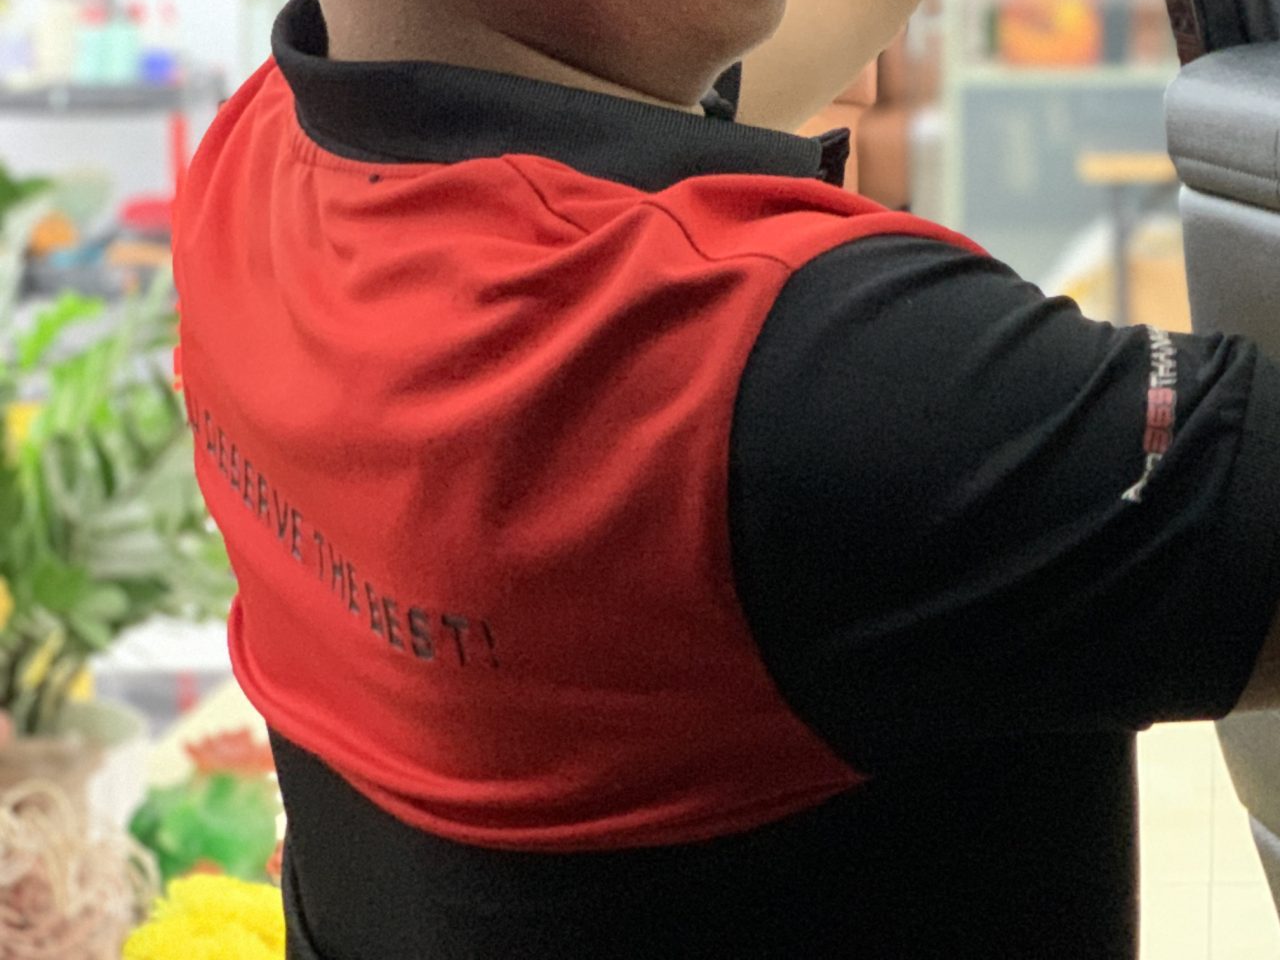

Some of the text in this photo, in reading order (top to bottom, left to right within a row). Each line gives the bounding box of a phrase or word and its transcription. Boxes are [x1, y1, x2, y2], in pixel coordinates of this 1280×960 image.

[203, 408, 303, 561] DESERVE
[313, 530, 361, 614] THE
[364, 581, 500, 669] BEST!
